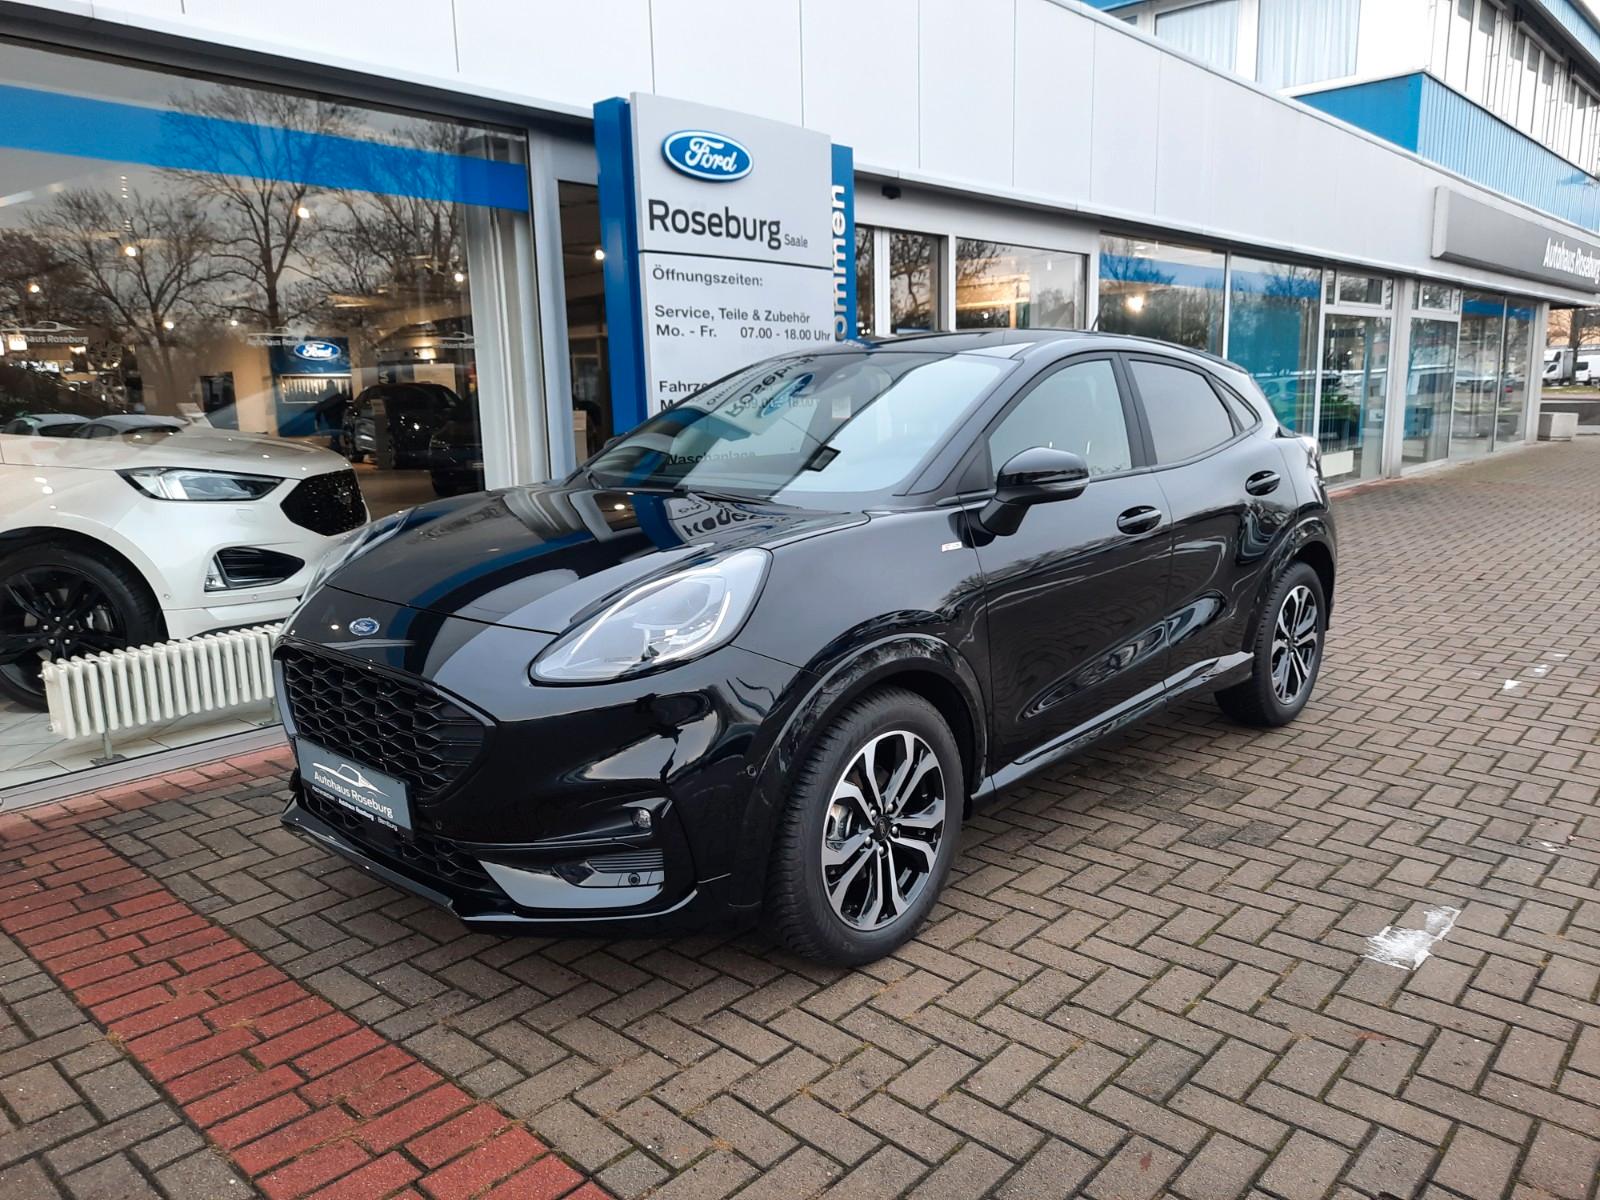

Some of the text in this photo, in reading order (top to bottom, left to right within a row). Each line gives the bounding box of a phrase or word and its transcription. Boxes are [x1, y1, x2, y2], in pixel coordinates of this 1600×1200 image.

[684, 137, 738, 172] Ford
[648, 198, 808, 251] Roseburg Saale
[1543, 237, 1576, 274] Autohaus
[652, 264, 764, 287] Öffnungszeiten:
[654, 304, 811, 324] Service, Teile & Zubehör
[656, 324, 685, 337] Mo.
[700, 325, 717, 338] Fr.
[740, 326, 773, 339] 07.00
[784, 328, 812, 341] 18.00
[814, 329, 831, 341] Uhr
[314, 770, 352, 798] Autohaus
[351, 789, 394, 819] Roseburg
